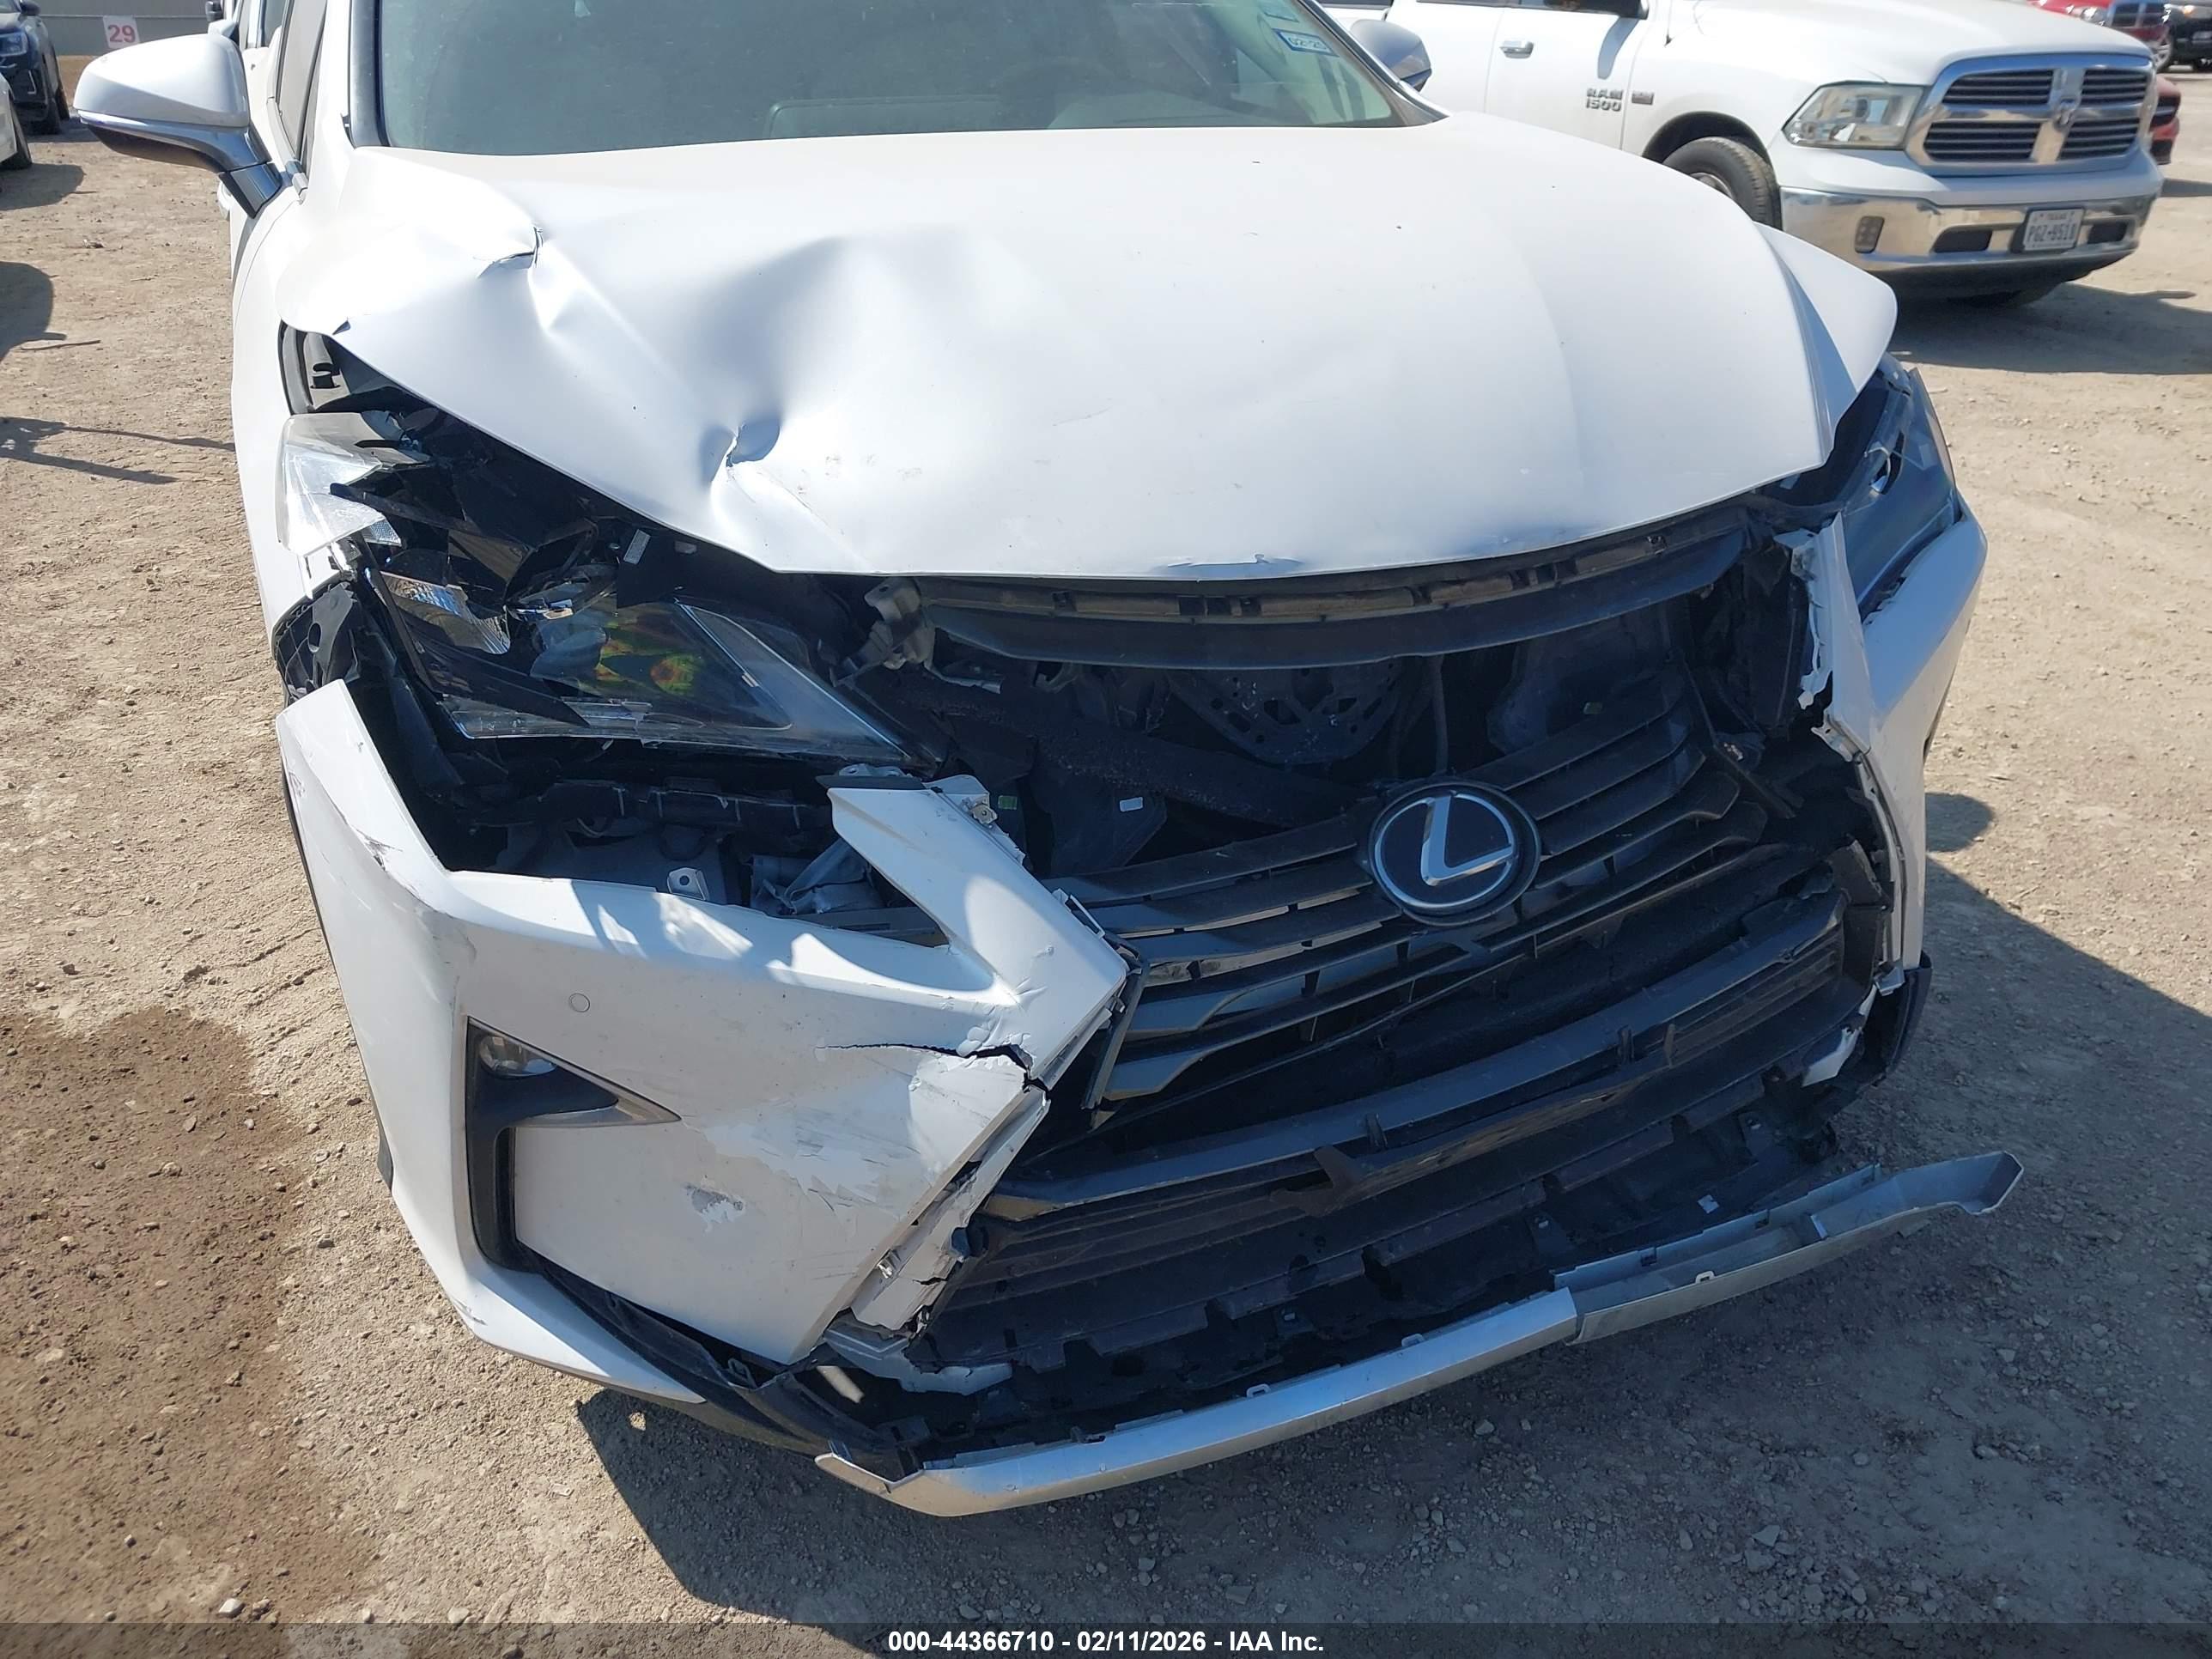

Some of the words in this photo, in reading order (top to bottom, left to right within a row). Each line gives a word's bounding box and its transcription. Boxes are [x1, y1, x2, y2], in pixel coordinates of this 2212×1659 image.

[107, 24, 136, 43] 29
[1586, 88, 1623, 100] RAM
[1586, 98, 1622, 112] 1500
